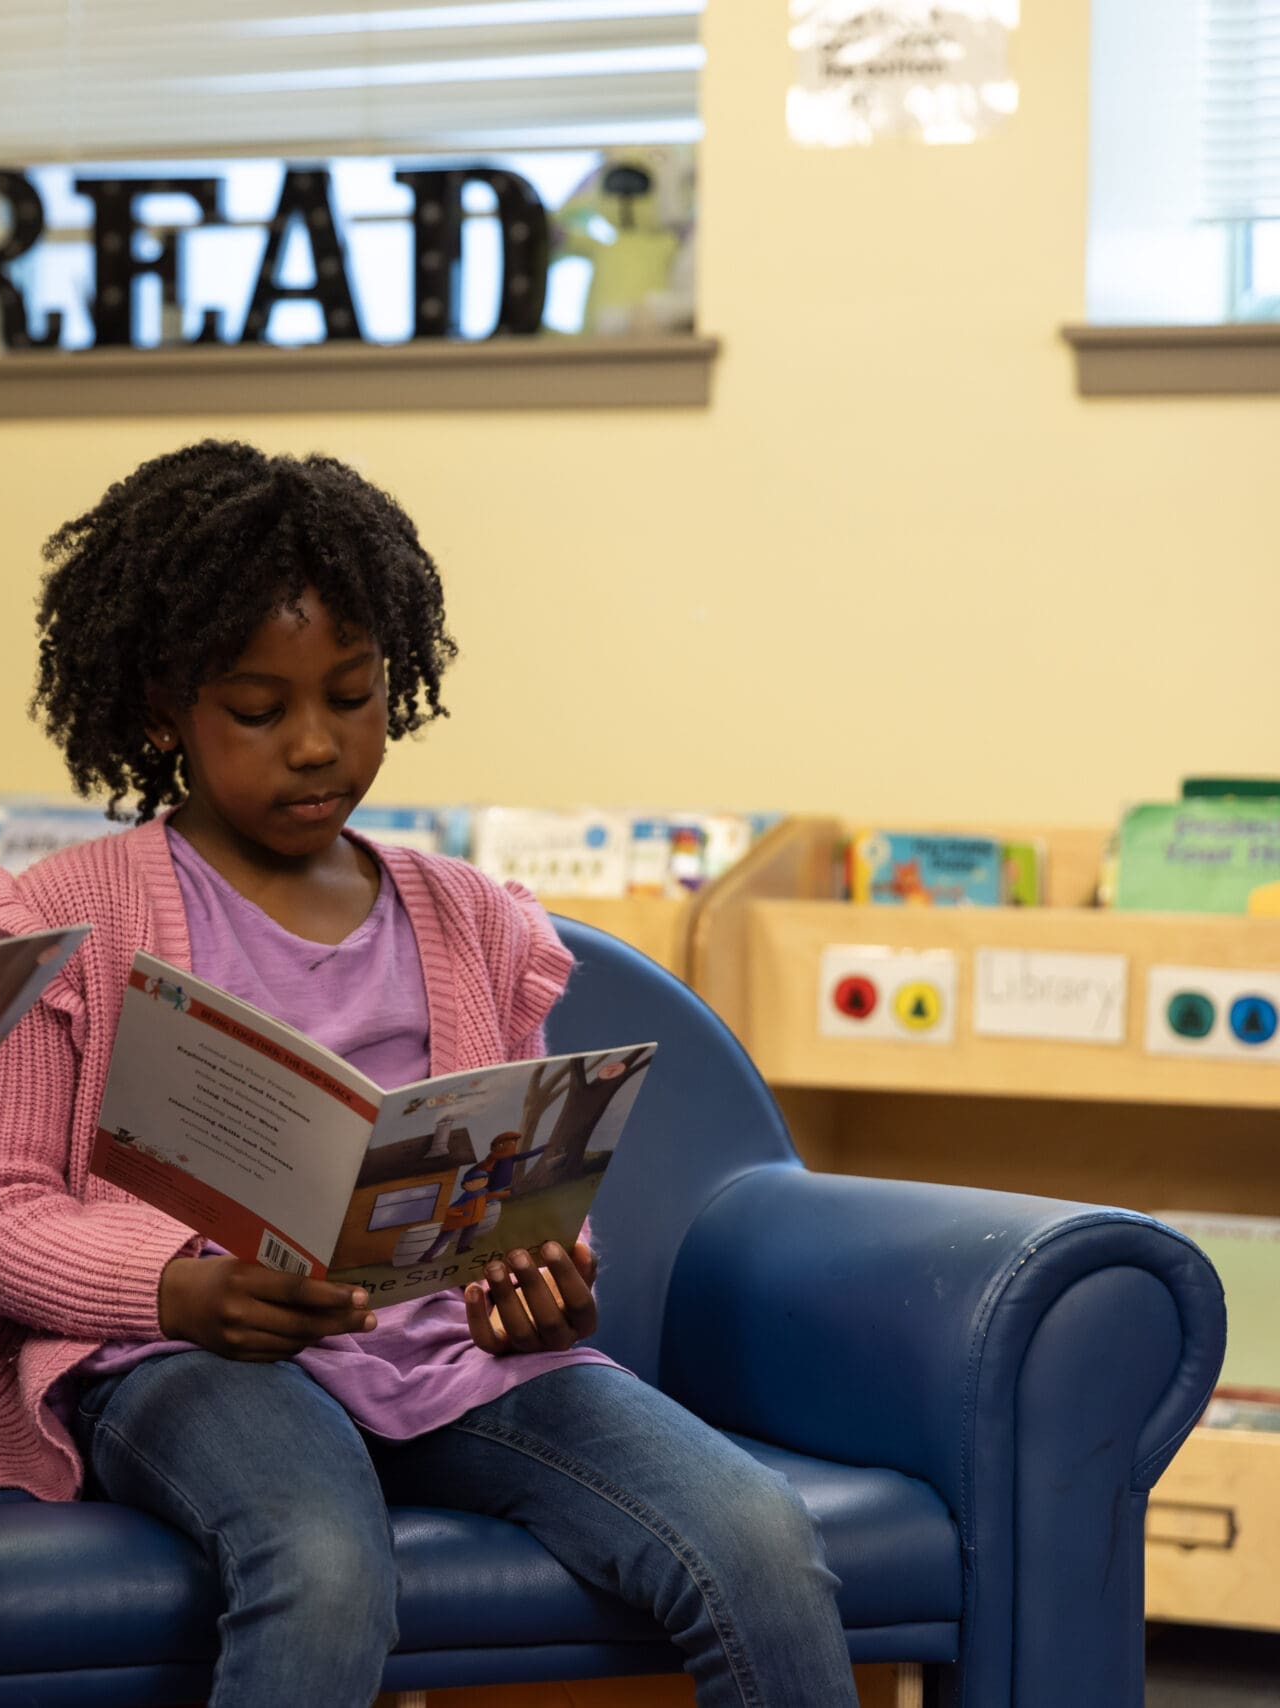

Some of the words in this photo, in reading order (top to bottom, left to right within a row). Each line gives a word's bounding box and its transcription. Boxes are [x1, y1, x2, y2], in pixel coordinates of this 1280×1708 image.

[982, 951, 1120, 1032] Library
[248, 1083, 263, 1094] and
[196, 1084, 219, 1099] Using
[244, 1110, 257, 1119] for
[258, 1118, 279, 1131] Work
[241, 1137, 257, 1148] and
[352, 1279, 396, 1294] he
[404, 1265, 459, 1287] Sap
